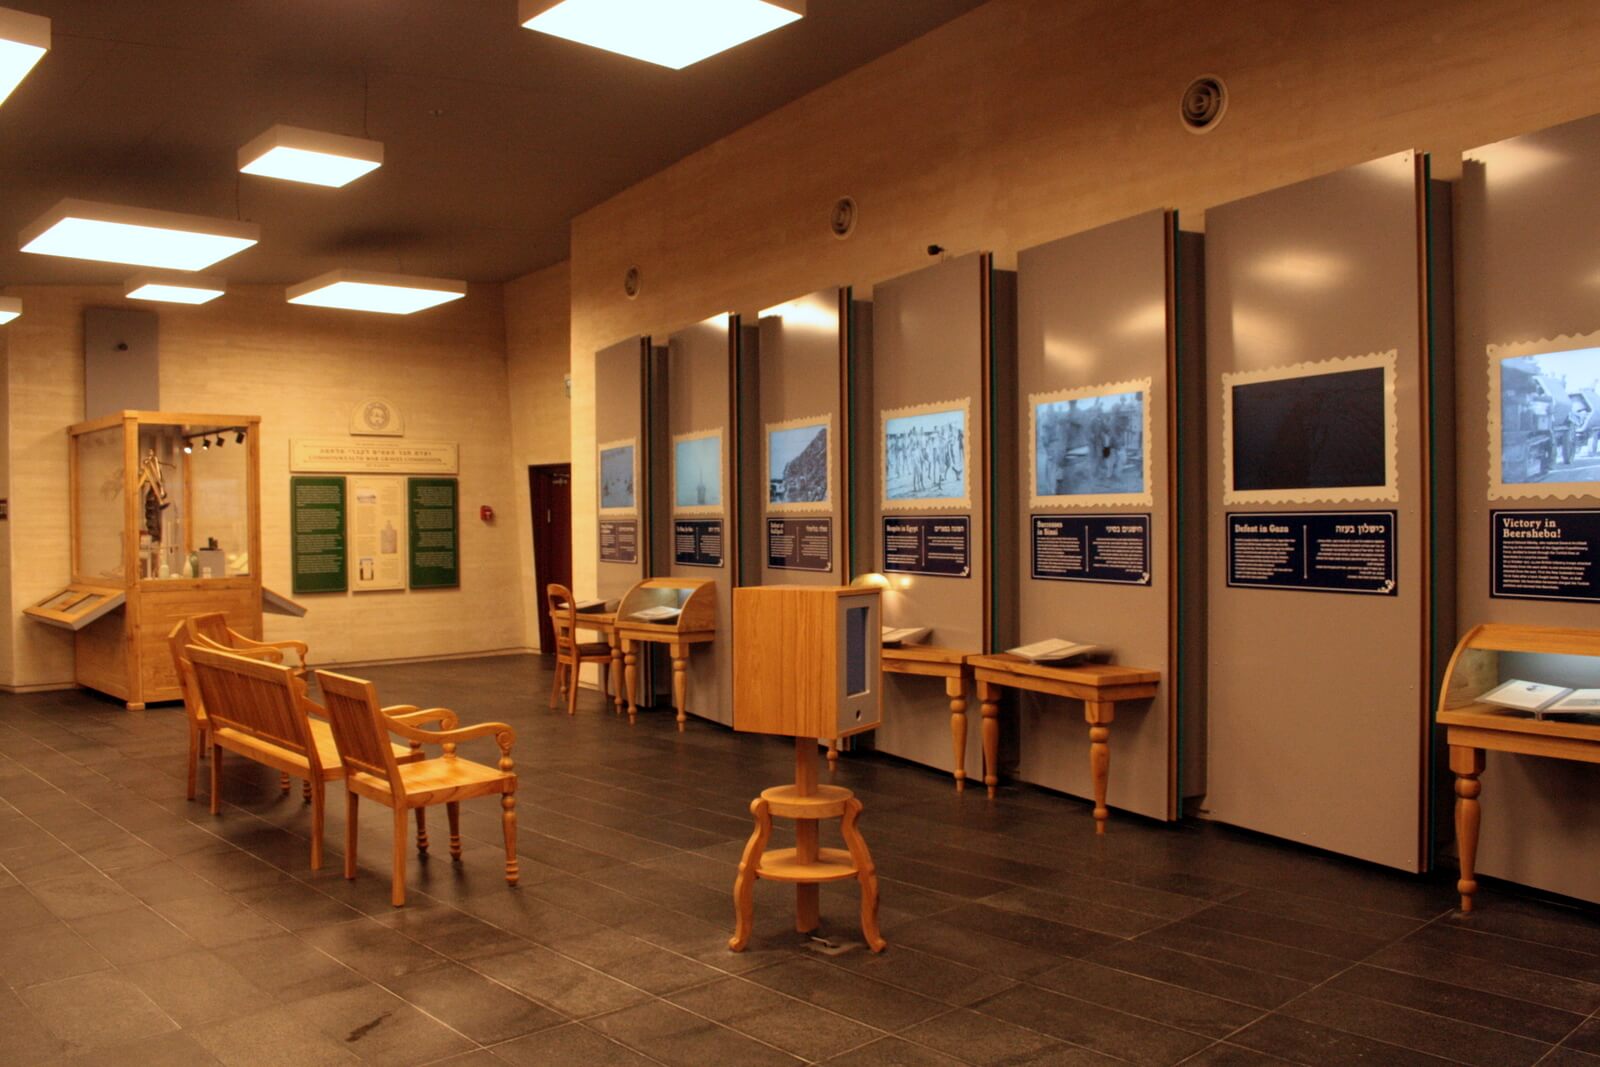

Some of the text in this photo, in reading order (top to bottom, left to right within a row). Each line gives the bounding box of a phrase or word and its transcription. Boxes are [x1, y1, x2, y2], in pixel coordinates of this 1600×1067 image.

[1234, 524, 1290, 533] Defeat in Gaza
[1503, 518, 1557, 530] Victory in
[1503, 528, 1561, 538] Beersheba!
